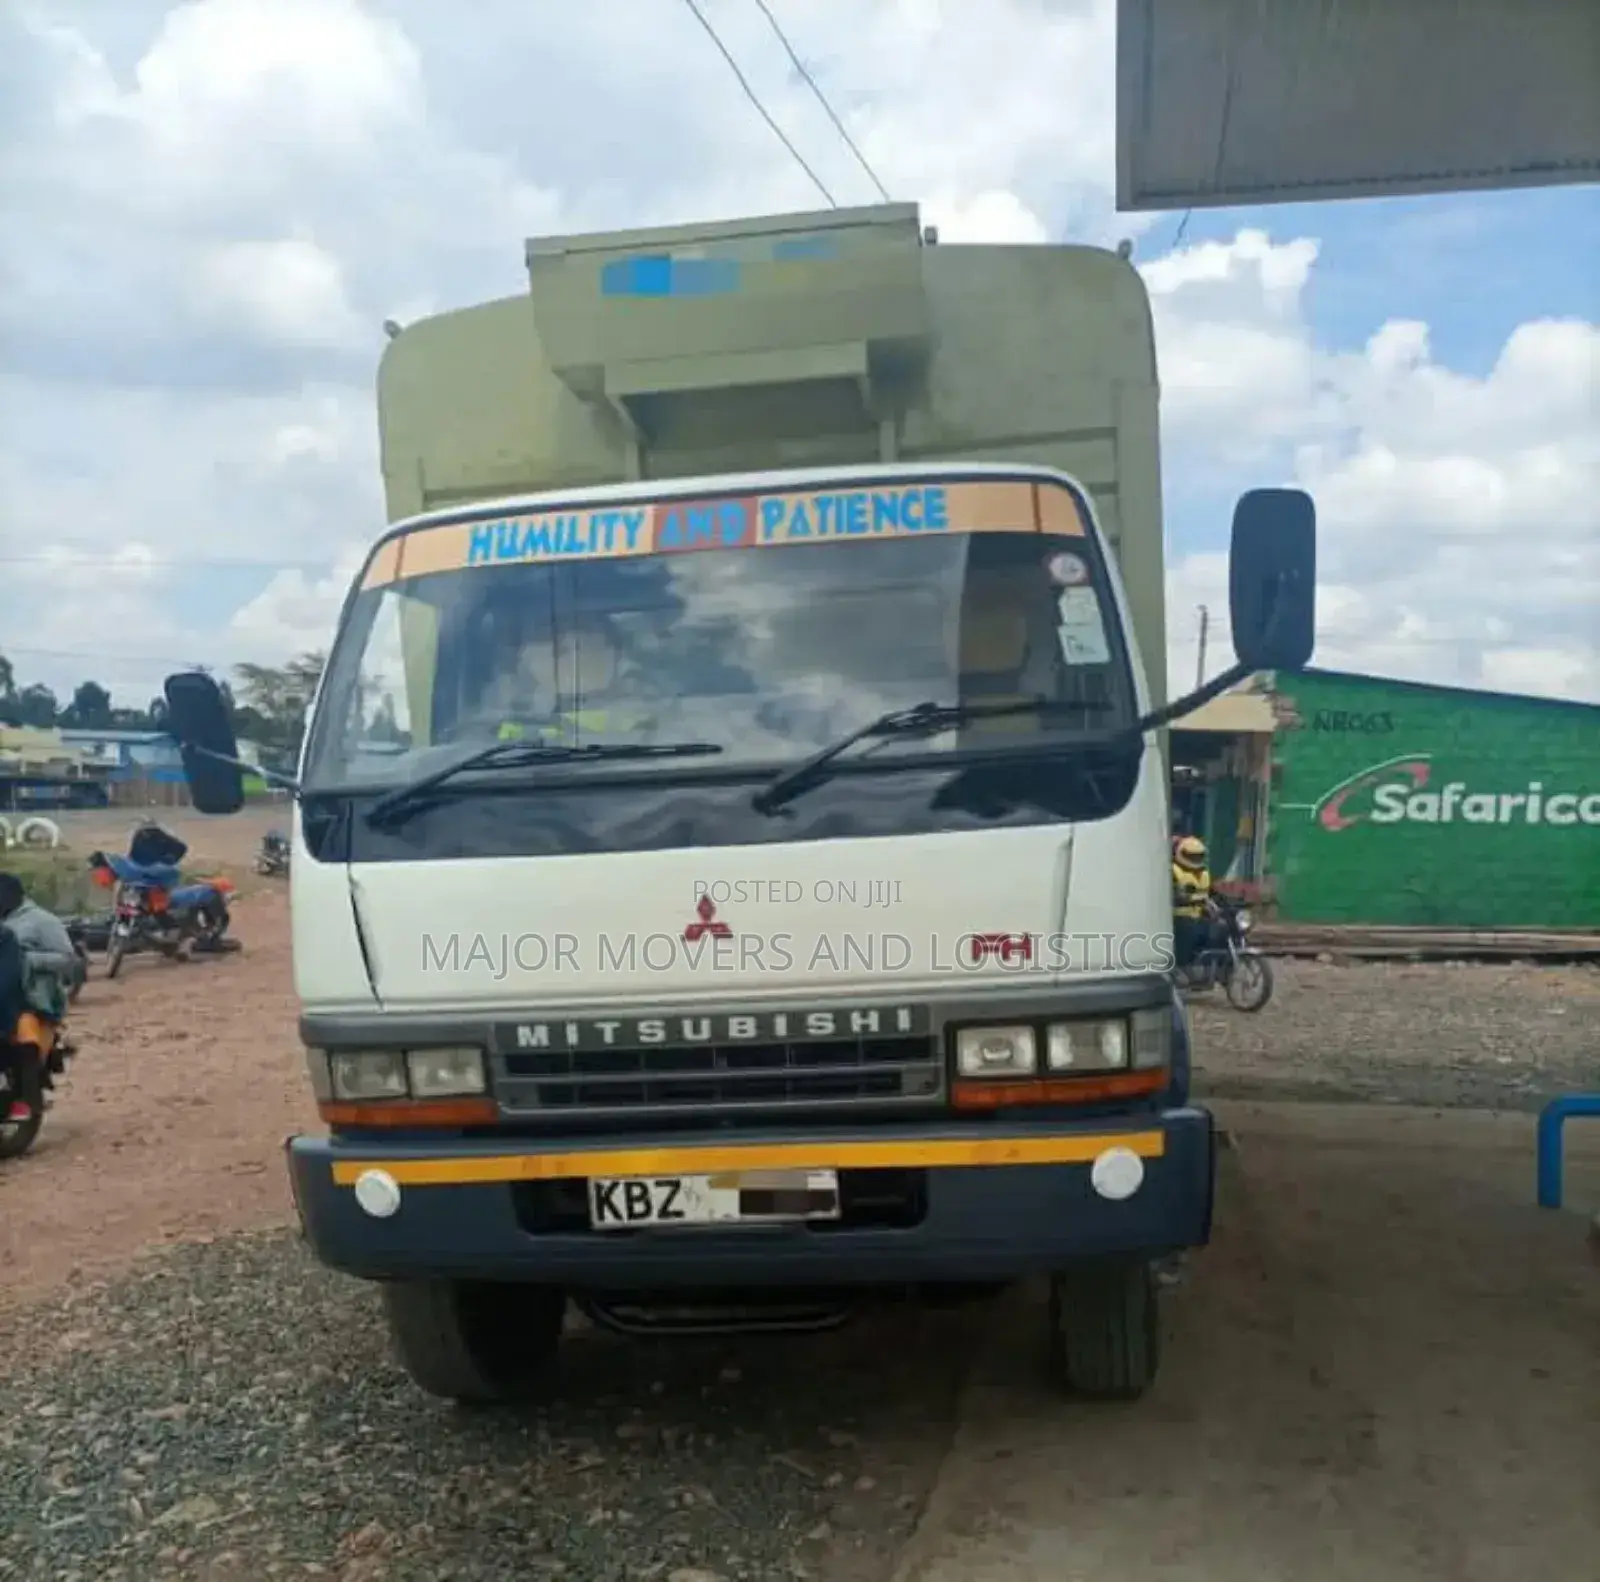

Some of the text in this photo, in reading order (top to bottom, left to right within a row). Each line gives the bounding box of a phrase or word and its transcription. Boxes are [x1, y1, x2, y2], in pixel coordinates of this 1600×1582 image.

[468, 488, 947, 567] HUMILITY AND PATIENCE
[516, 1008, 912, 1048] MITSUBISHI
[595, 1179, 685, 1221] KBZ
